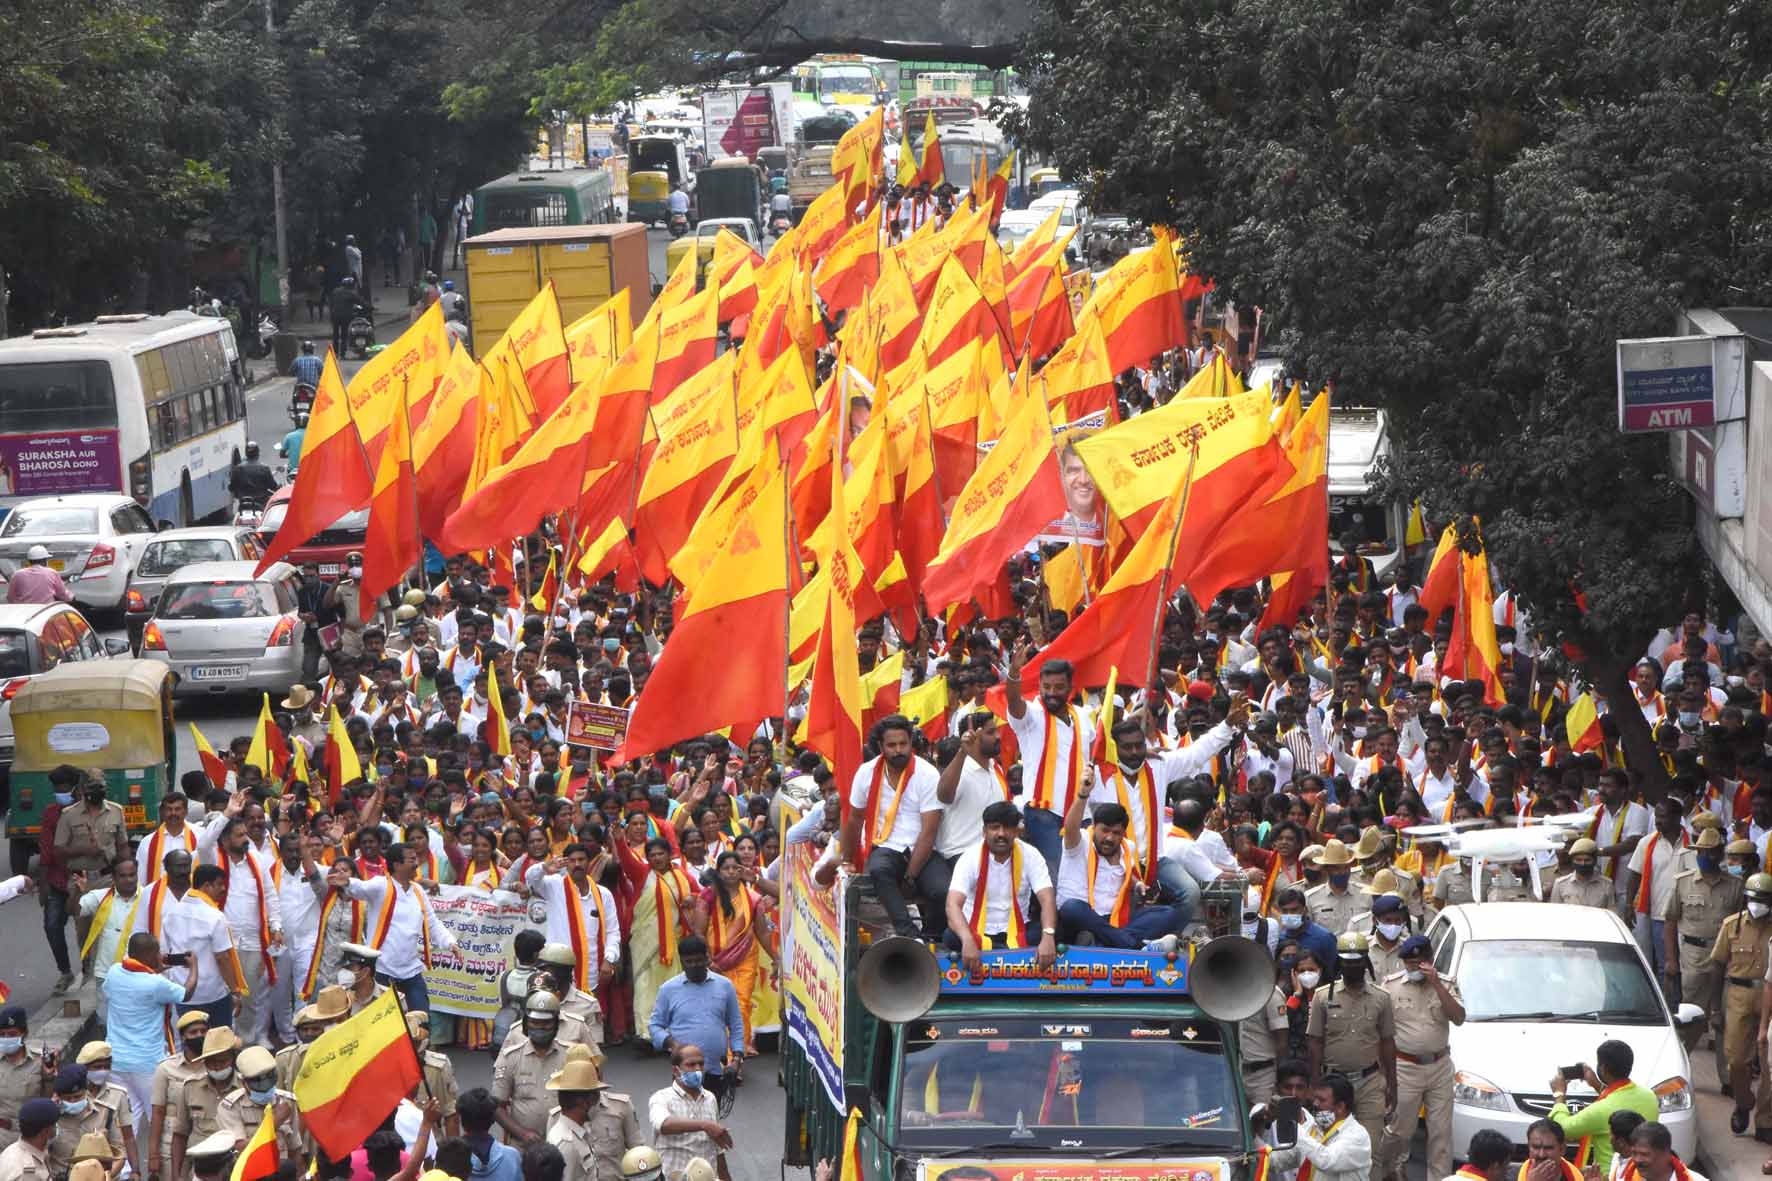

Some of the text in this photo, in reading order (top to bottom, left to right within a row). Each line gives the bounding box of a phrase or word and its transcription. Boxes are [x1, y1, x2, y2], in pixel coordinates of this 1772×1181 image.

[1648, 408, 1692, 427] ATM
[18, 450, 96, 461] SURAKSHA AUR
[1131, 438, 1176, 468] ಕರ್ನಾಟಕ
[19, 460, 99, 471] BHAROSA DONO
[457, 923, 479, 937] ಮತ್ತು
[465, 958, 507, 983] ಮುತ್ತಿಗೆ
[1070, 962, 1108, 985] ಸ್ವಾಮಿ
[1111, 959, 1155, 986] ಪ್ರಸನ್ನ
